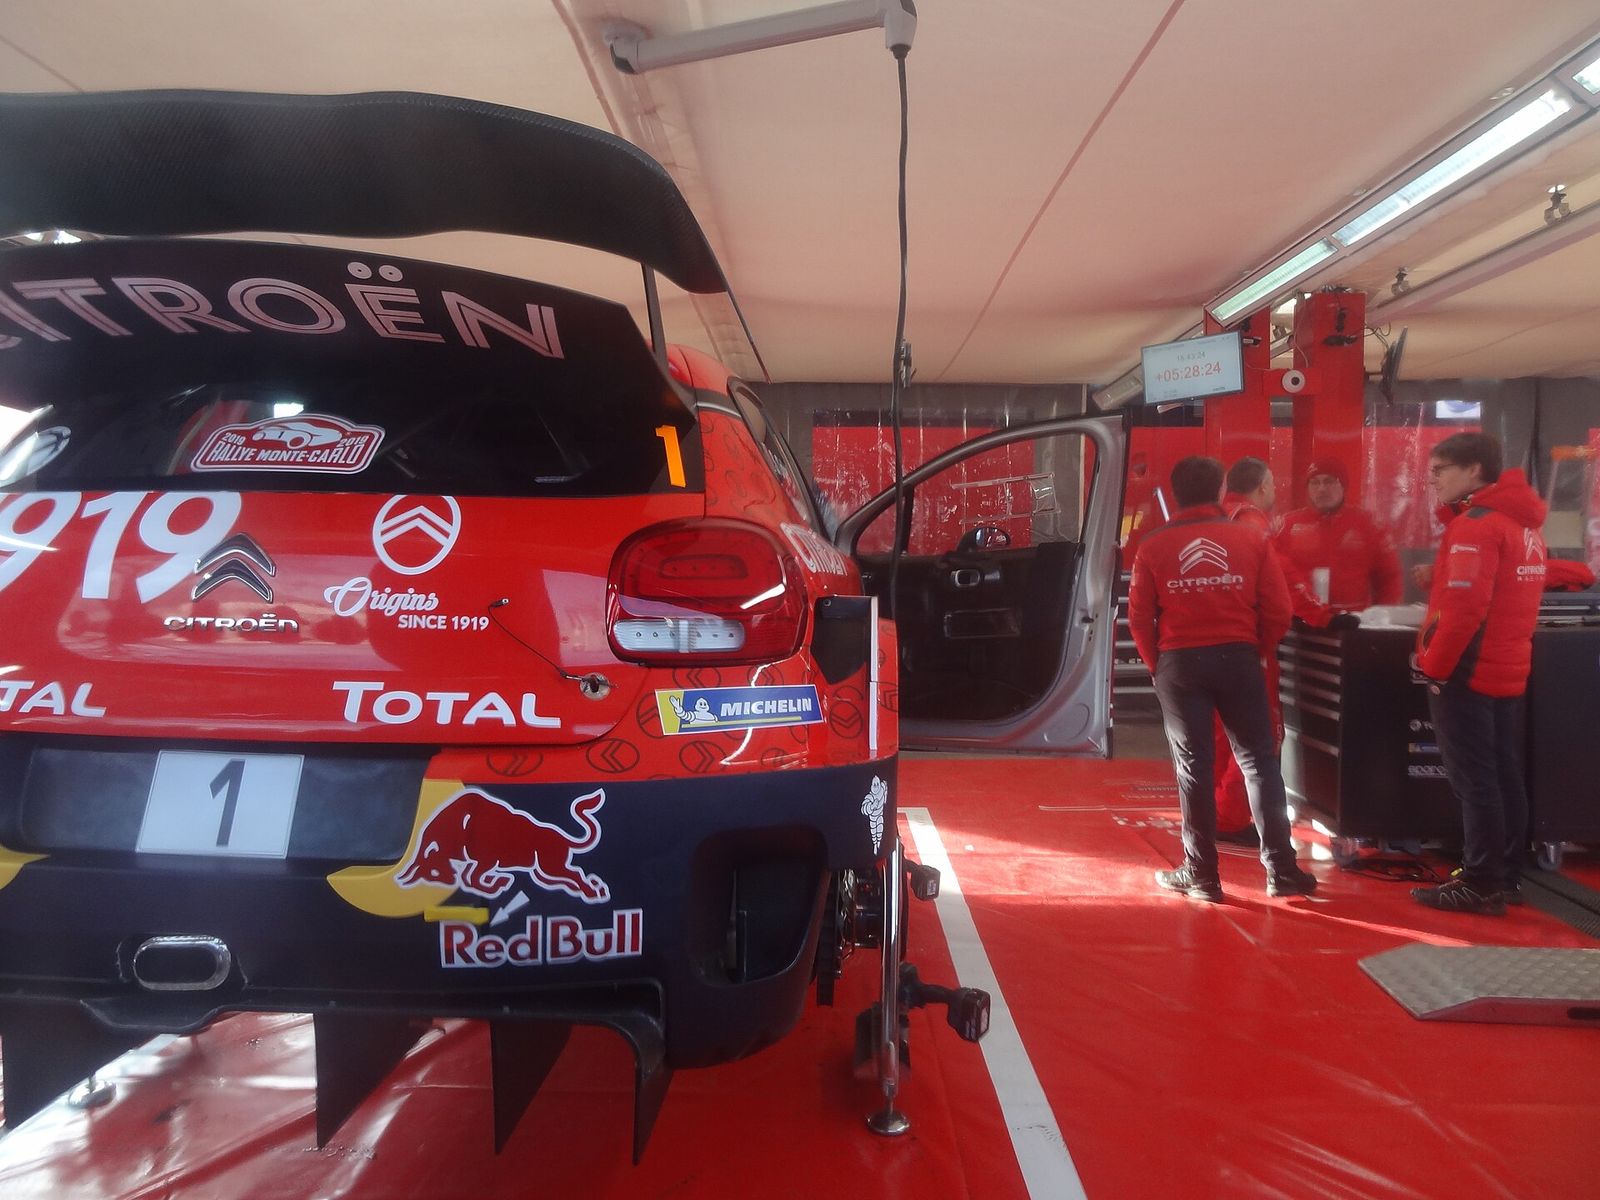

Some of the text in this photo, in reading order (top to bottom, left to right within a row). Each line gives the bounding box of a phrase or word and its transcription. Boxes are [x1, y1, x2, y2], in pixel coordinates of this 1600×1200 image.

[0, 262, 564, 359] ITROËN
[206, 440, 365, 464] RALLYE MONTE-CARLO
[222, 432, 246, 446] 2019
[336, 435, 369, 448] 2019
[655, 425, 687, 488] 1
[0, 491, 242, 604] 919
[323, 577, 439, 616] Origins
[1167, 573, 1243, 588] CITROËN
[163, 613, 298, 633] CITROËN
[398, 614, 490, 631] SINCE 1919
[0, 680, 107, 718] TAL
[333, 681, 562, 729] TOTAL
[720, 697, 813, 718] MICHELIN
[208, 758, 246, 848] 1
[440, 908, 644, 968] Red Bull
